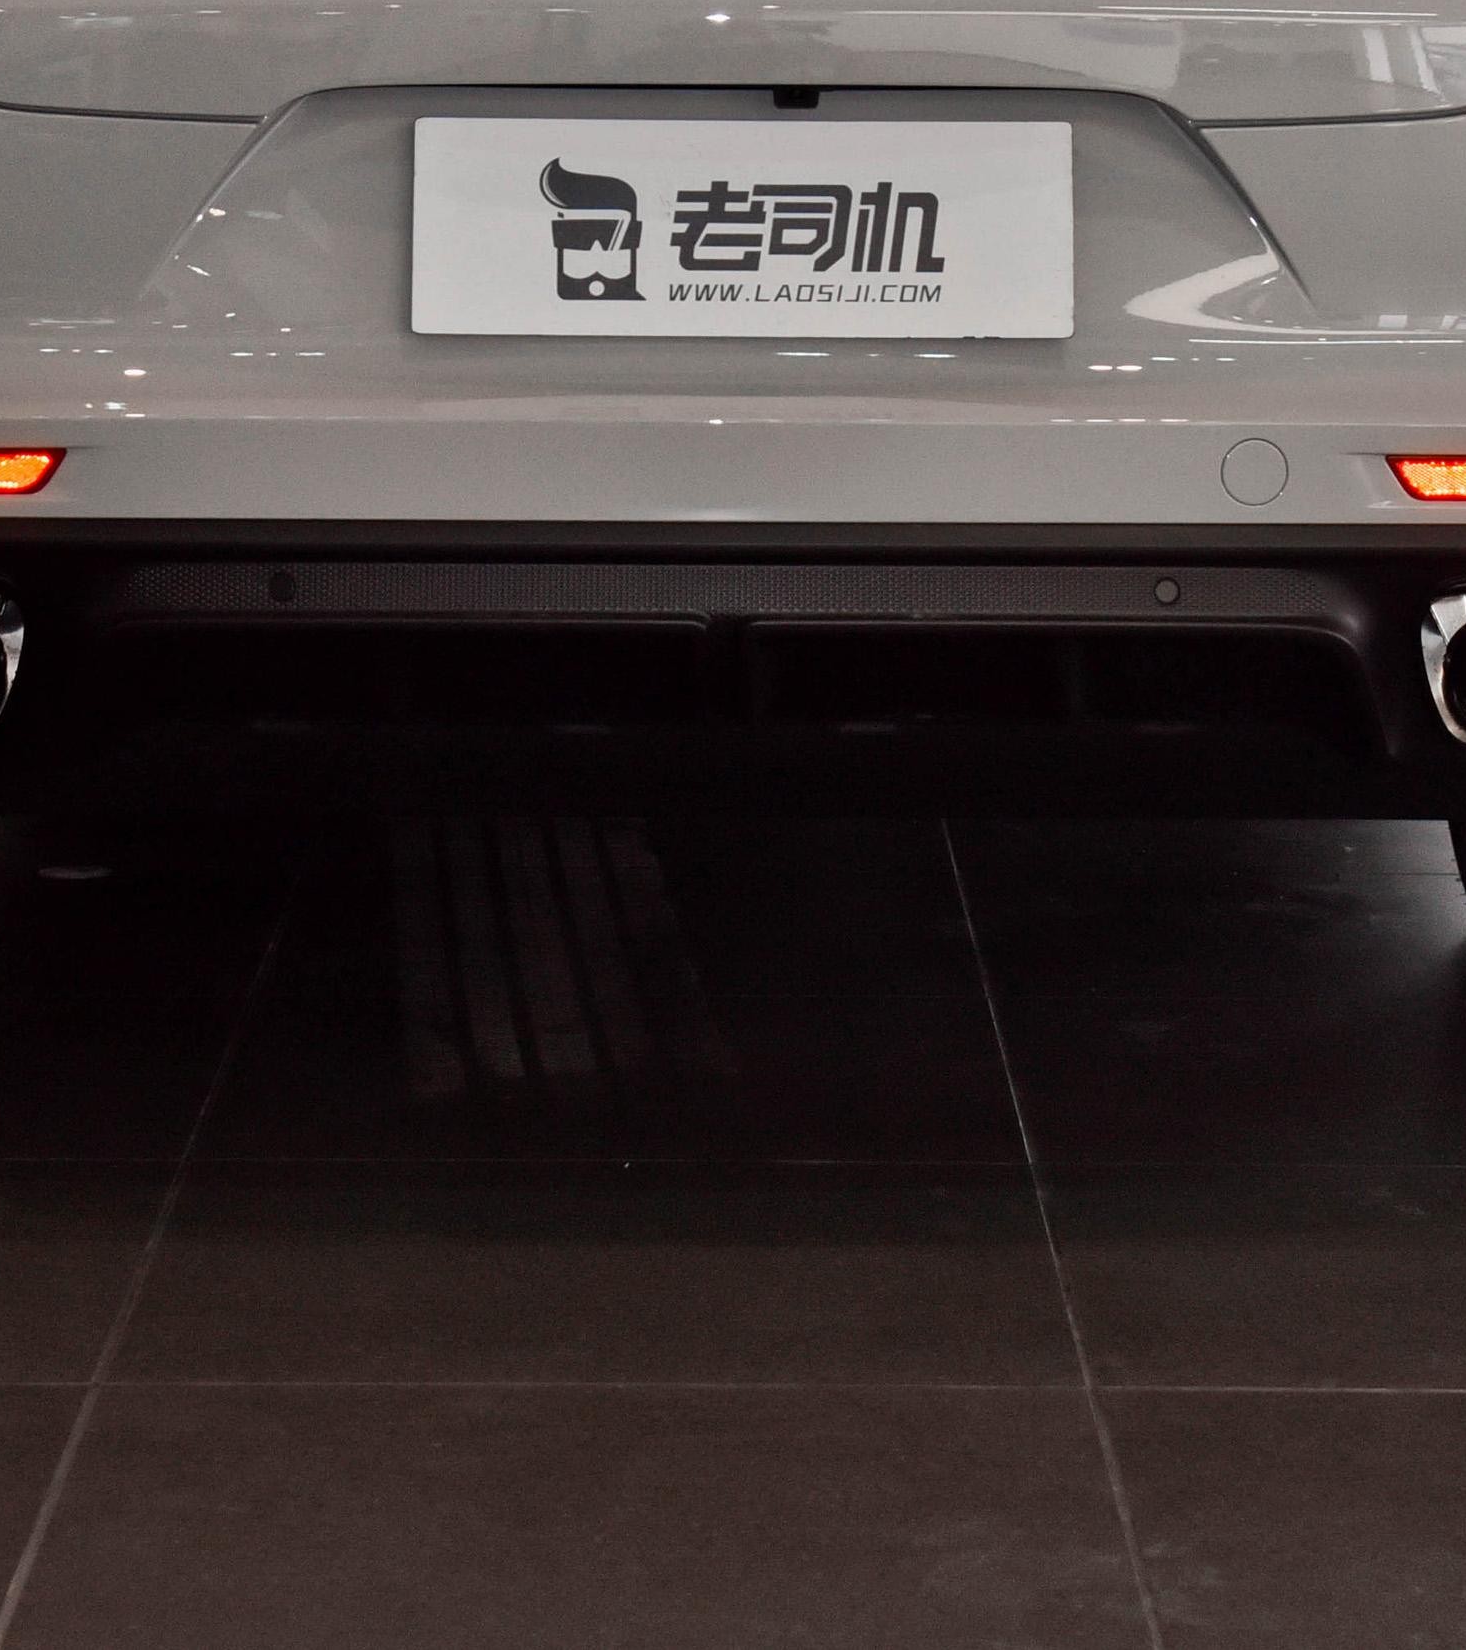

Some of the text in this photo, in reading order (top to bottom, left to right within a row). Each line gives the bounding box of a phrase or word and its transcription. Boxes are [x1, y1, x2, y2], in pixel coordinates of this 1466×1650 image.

[669, 180, 946, 274] 老司机
[667, 282, 943, 305] WWW.LAOSIJI.COM
